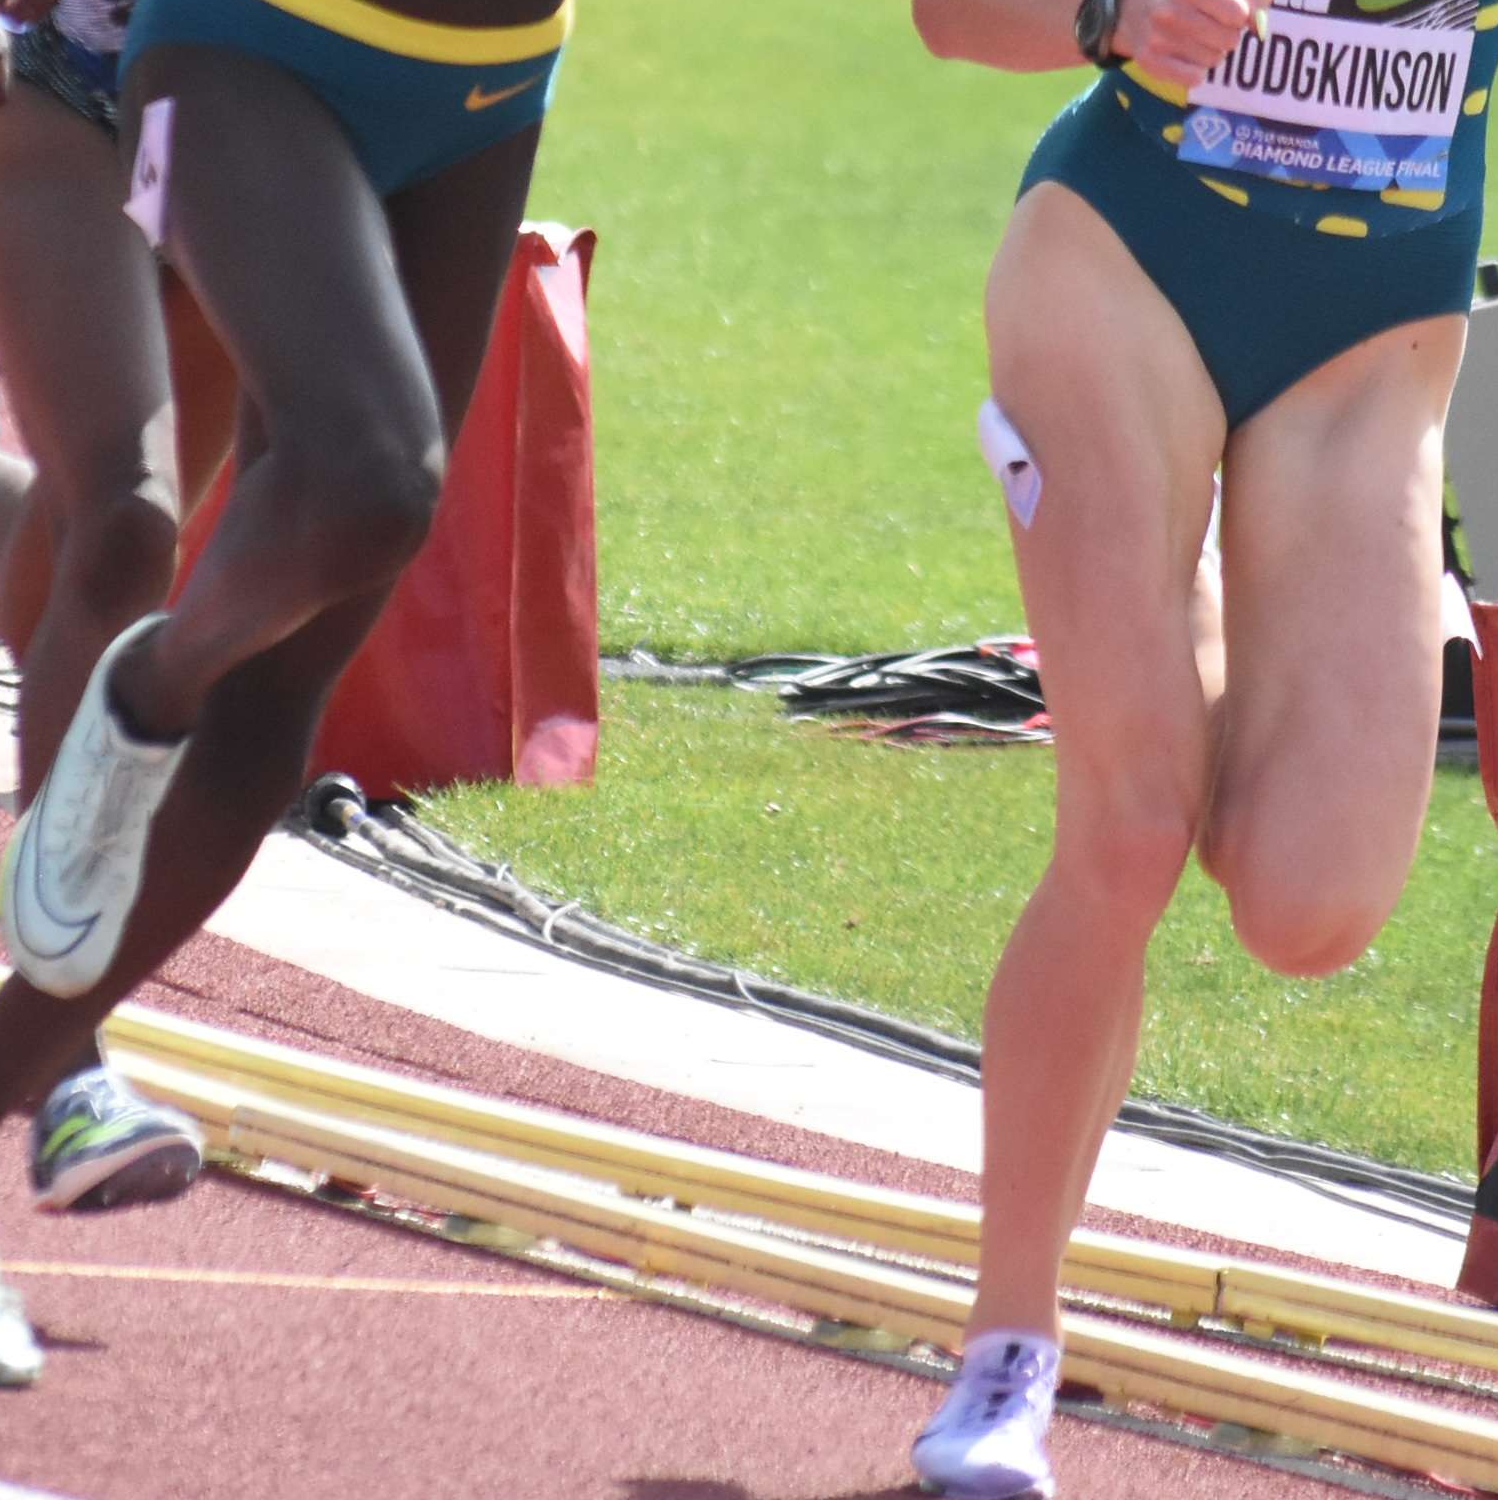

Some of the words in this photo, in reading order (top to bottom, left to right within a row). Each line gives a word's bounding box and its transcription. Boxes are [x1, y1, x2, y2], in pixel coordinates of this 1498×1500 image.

[1232, 140, 1323, 169] DIAMOND
[1326, 154, 1396, 177] LEAGUE
[1397, 161, 1441, 178] FINAL
